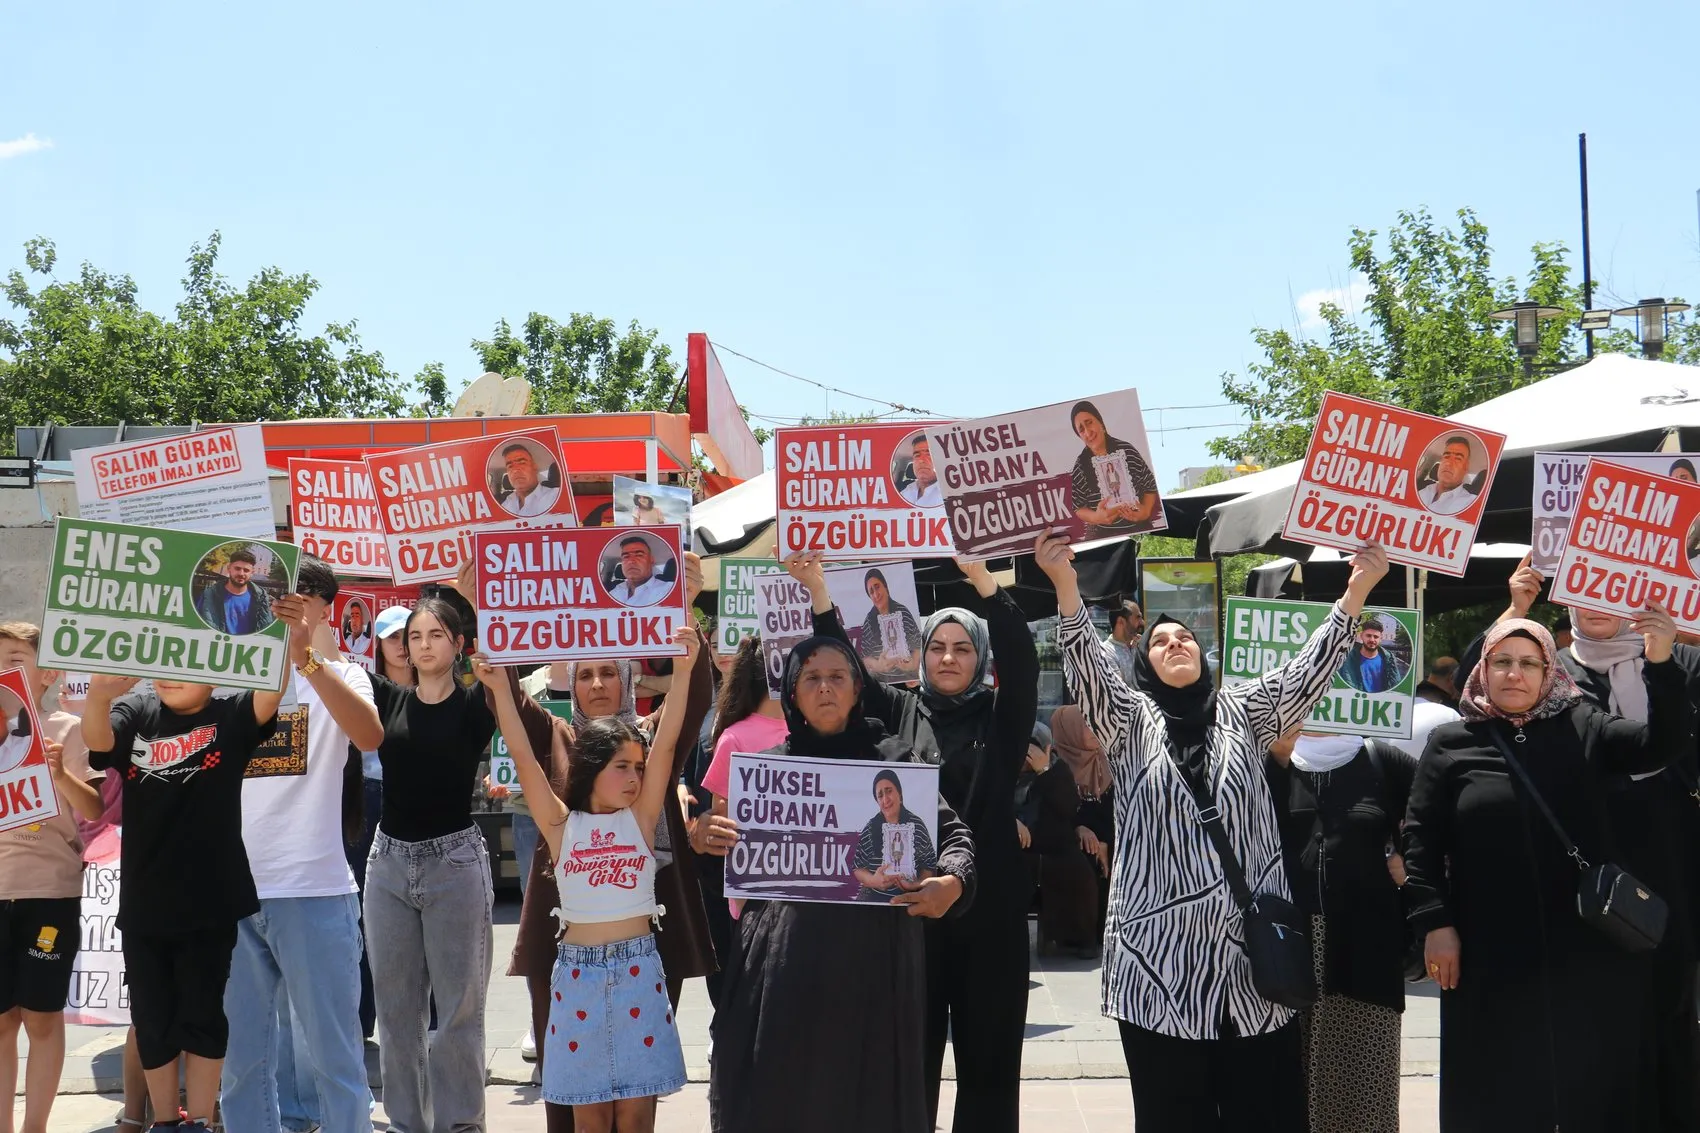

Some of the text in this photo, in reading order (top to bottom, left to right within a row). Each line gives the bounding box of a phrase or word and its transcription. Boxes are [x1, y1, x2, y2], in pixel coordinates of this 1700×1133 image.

[785, 433, 871, 473] SALİM
[934, 423, 1026, 459] YÜKSEL
[1322, 409, 1410, 460] SALİM
[97, 434, 233, 478] SALİM GÜRAN
[101, 470, 157, 494] TELEFON
[160, 463, 193, 482] İMAJ
[197, 455, 236, 475] KAYDI
[378, 453, 468, 498] SALİM
[944, 451, 1048, 490] GÜRAN'A
[1310, 447, 1410, 500] GÜRAN'A
[296, 466, 375, 500] SALİM
[785, 473, 888, 508] GÜRAN'A
[1587, 476, 1680, 528] SALİM
[387, 491, 492, 532] GÜRAN'A
[787, 512, 949, 551] ÖZGÜRLÜK
[953, 483, 1072, 541] ÖZGÜRLÜK
[1297, 489, 1462, 560] ÖZGÜRLÜK!
[63, 528, 163, 576] ENES
[485, 535, 578, 574] SALİM
[1577, 514, 1680, 569] GÜRAN'A
[57, 570, 184, 618] GÜRAN'A
[485, 574, 597, 608] GÜRAN'A
[487, 611, 674, 652] ÖZGÜRLÜK!
[1233, 608, 1309, 645] ENES
[52, 618, 273, 678] ÖZGÜRLÜK!
[738, 763, 826, 798] YÜKSEL
[736, 793, 839, 829] GÜRAN'A
[563, 855, 648, 877] Powerpuff
[731, 833, 851, 877] ÖZGÜRLÜK
[588, 868, 637, 889] Girls
[28, 947, 61, 960] SIMPSON
